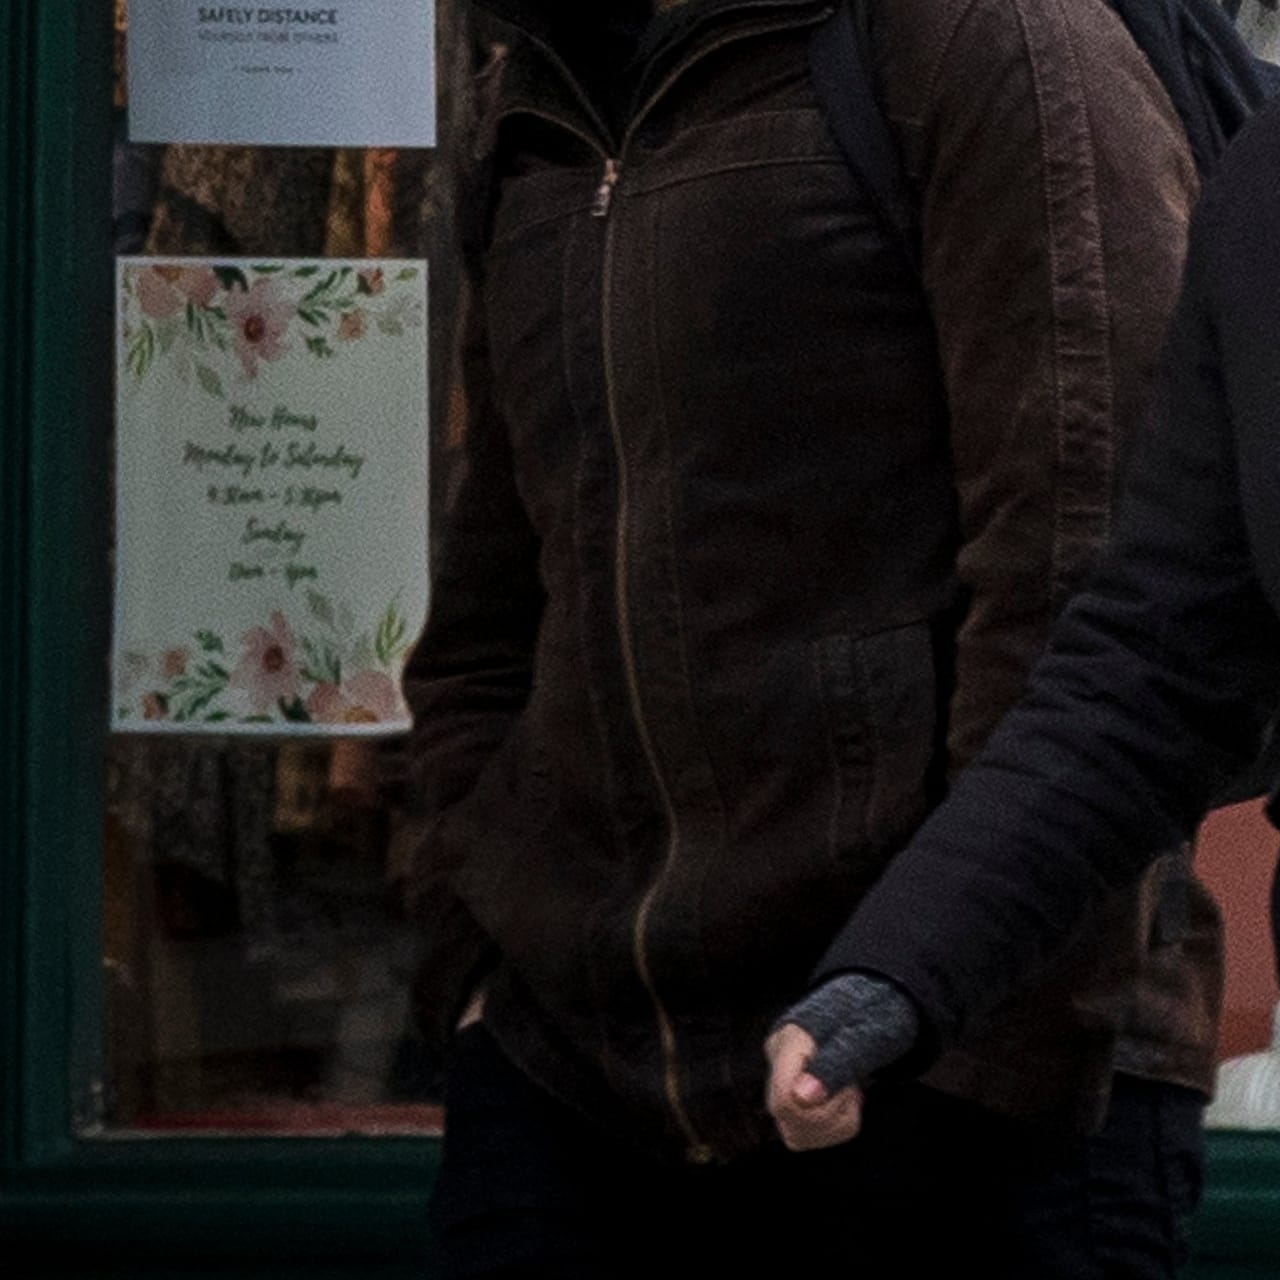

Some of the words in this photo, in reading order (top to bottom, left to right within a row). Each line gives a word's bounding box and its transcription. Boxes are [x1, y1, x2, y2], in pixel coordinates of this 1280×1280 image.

[198, 7, 253, 24] SAFELY
[257, 8, 337, 25] DISTANCE
[183, 440, 255, 478] Monday
[260, 441, 280, 469] to
[284, 441, 364, 480] Saturday
[241, 516, 306, 555] Sunday
